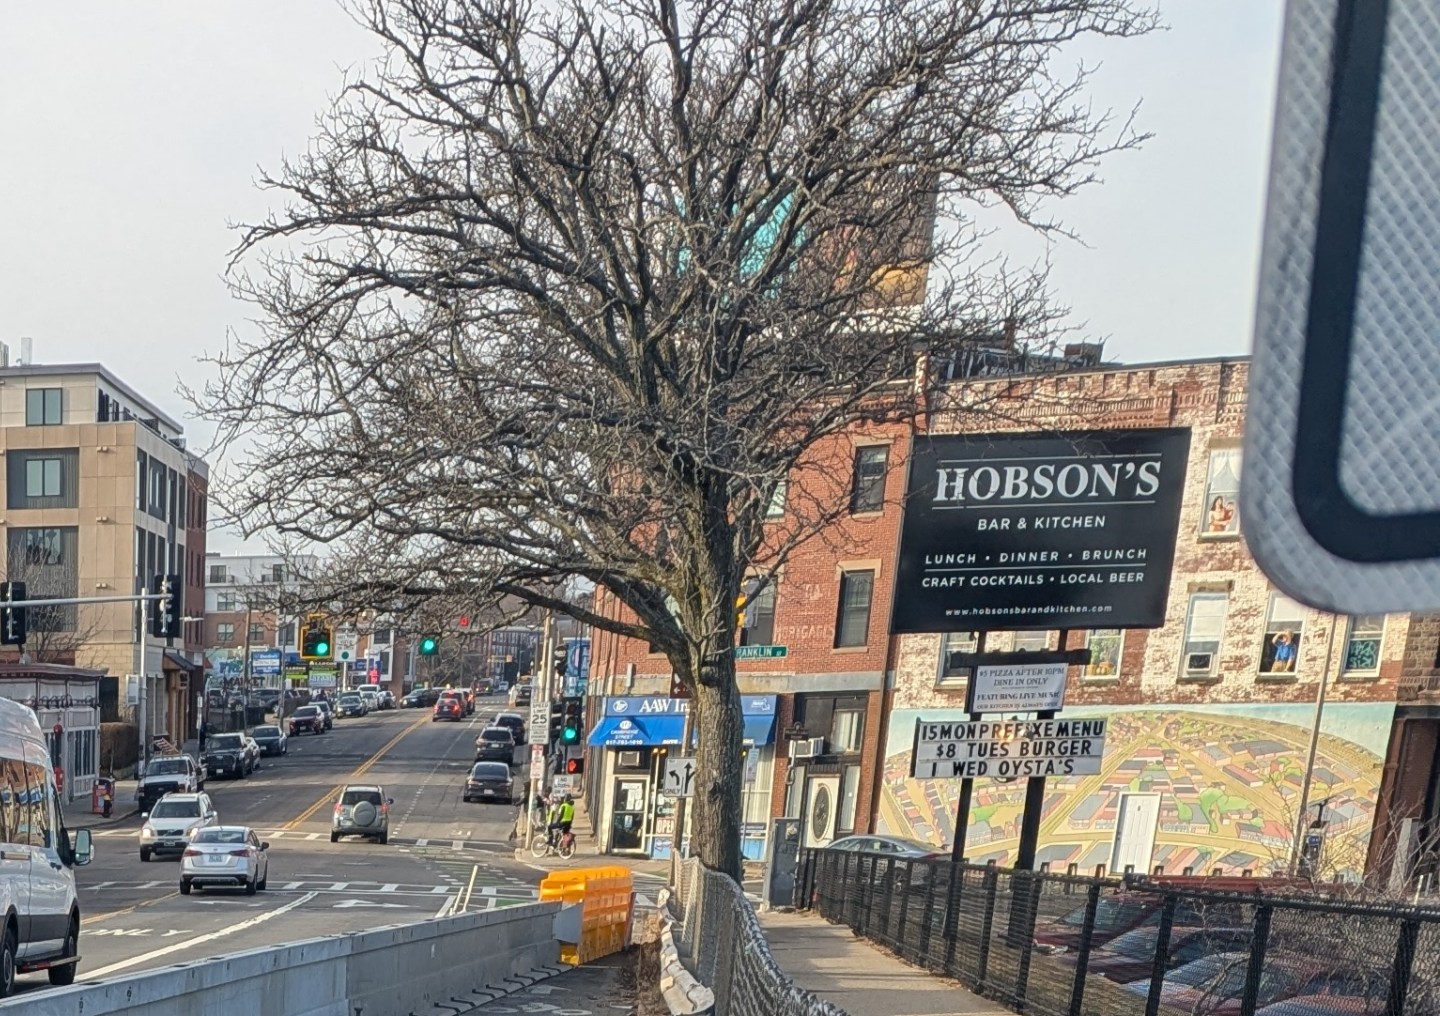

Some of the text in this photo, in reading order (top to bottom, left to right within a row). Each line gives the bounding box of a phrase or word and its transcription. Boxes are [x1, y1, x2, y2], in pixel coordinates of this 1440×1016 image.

[933, 461, 1161, 502] HOBSON'S
[977, 515, 1106, 531] BAR & KITCHEN
[925, 548, 1148, 565] LUNCH DINNER BRUNCH
[922, 572, 1145, 588] CRAFT COCKTAILS LOCAL BEER
[945, 604, 1112, 617] www.hobsonsbarandkitchen.com
[736, 647, 772, 657] RANKLIN
[989, 669, 1014, 677] PIZZA
[1015, 668, 1043, 676] AFTER
[994, 678, 1015, 686] DINE
[977, 693, 1018, 701] FEATURING
[1019, 692, 1036, 700] LIVE
[639, 699, 671, 712] AAW
[532, 714, 547, 724] 25
[937, 739, 1091, 758] $8 TUES BURGER
[953, 761, 987, 776] WED
[999, 759, 1074, 774] OYSTA'S
